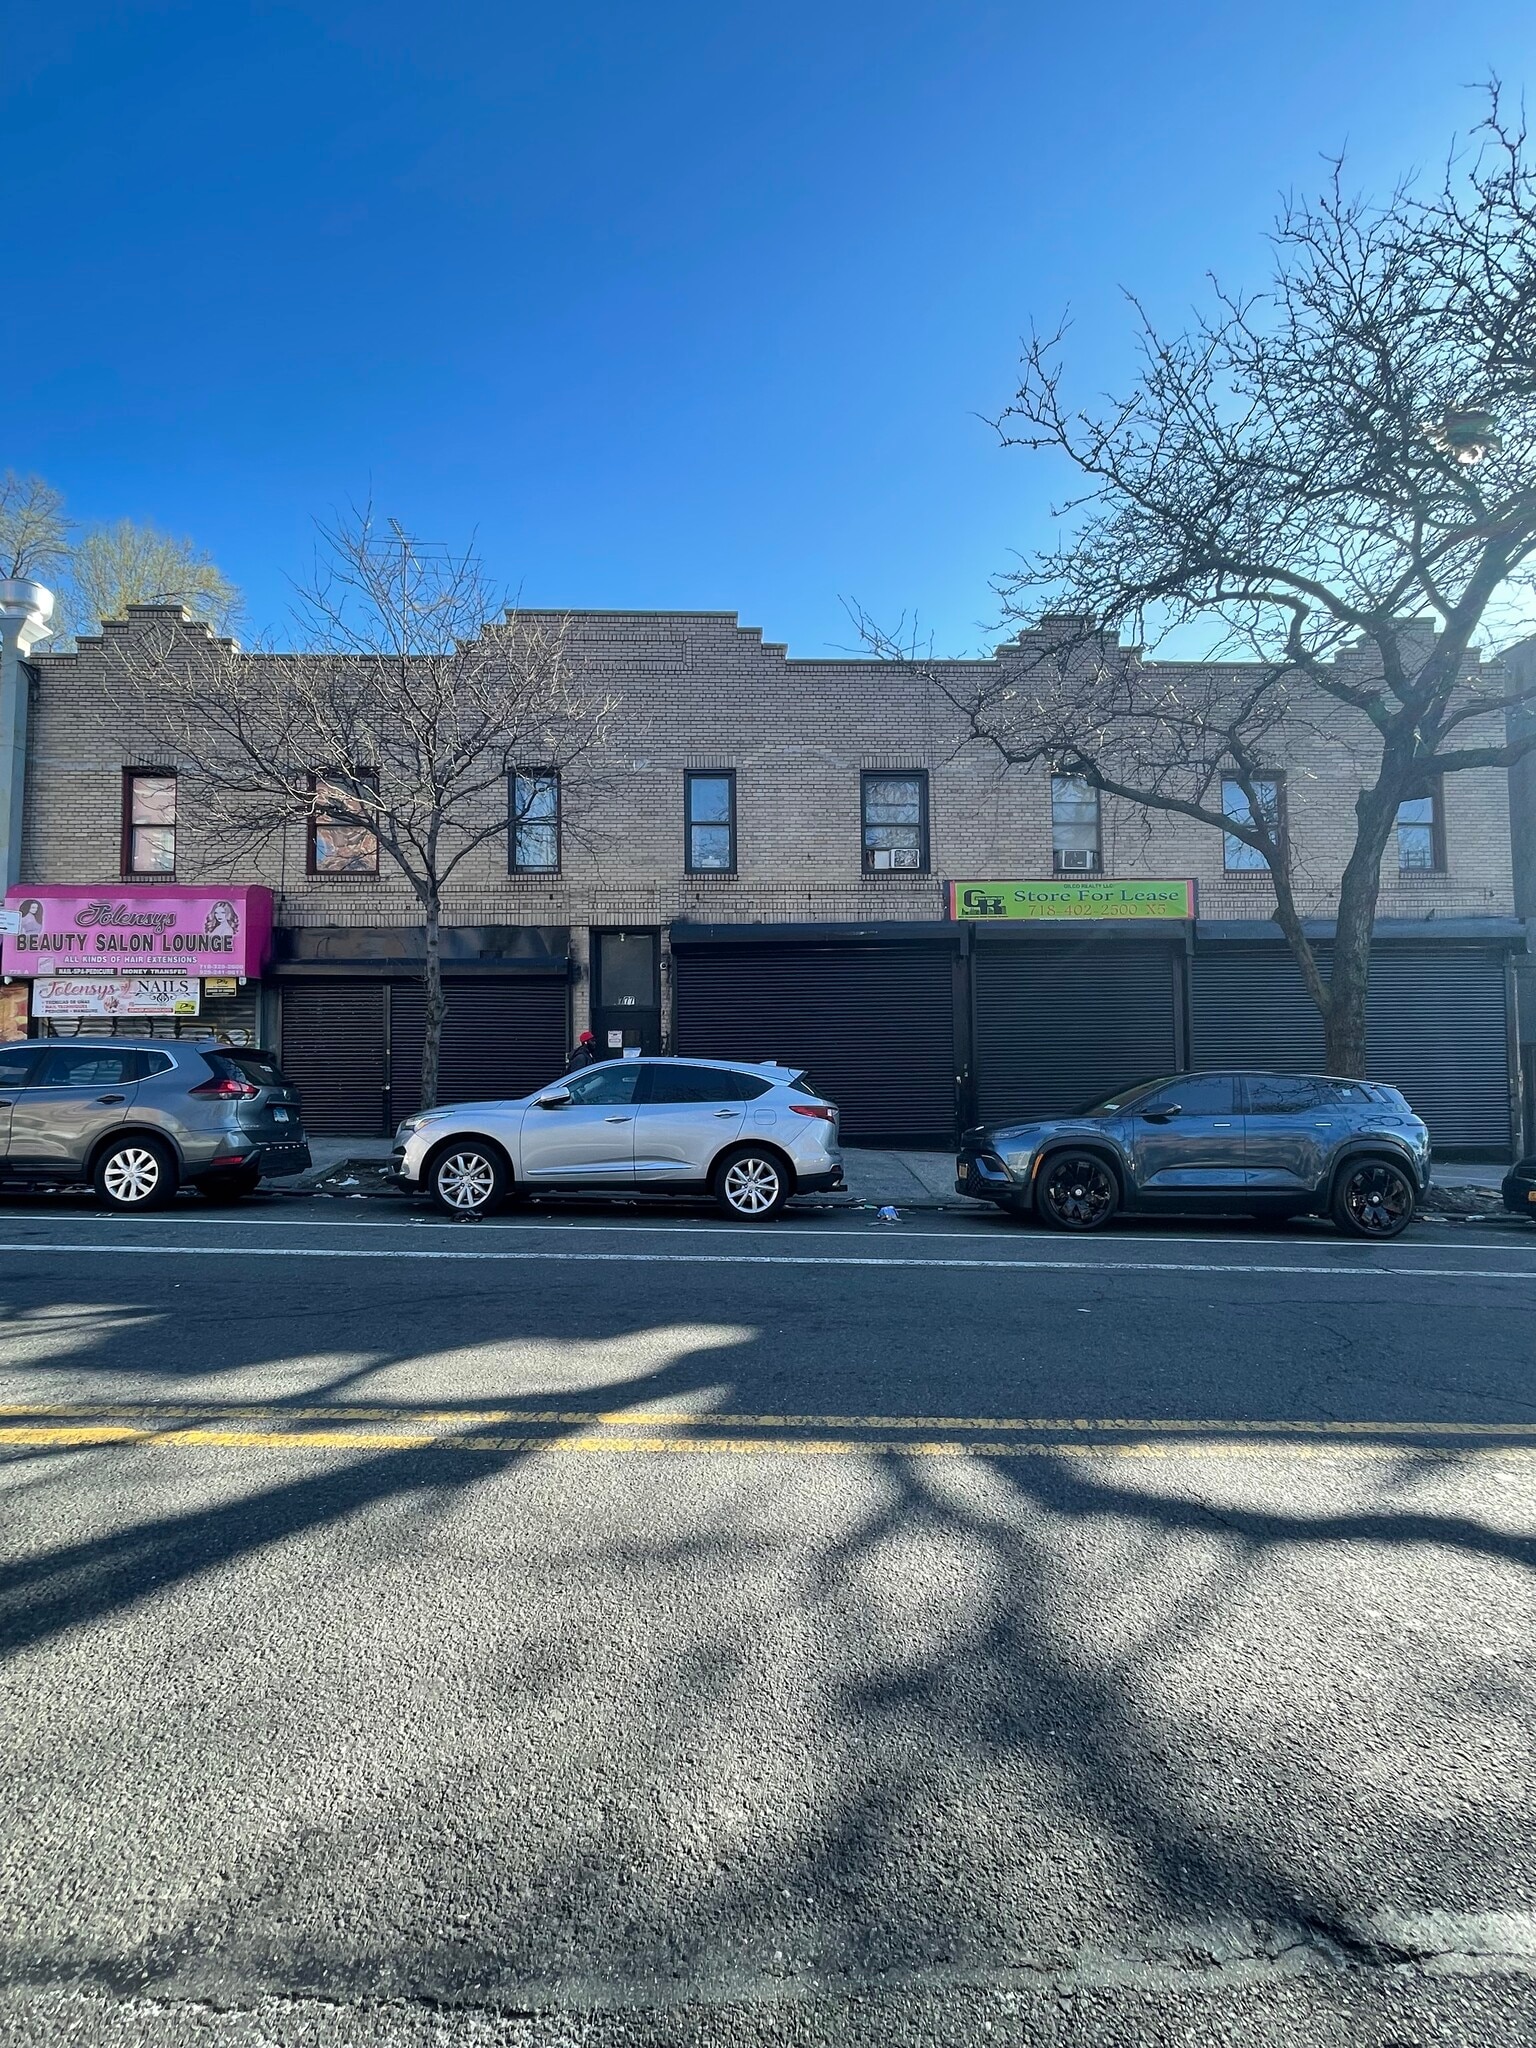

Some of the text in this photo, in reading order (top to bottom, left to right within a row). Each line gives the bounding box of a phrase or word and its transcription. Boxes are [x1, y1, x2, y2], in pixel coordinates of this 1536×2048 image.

[1014, 889, 1179, 902] Store For Lease
[1028, 904, 1166, 916] 718-402-2500 X5
[75, 902, 176, 934] Jolensys
[16, 933, 233, 953] BEAUTY SALON LOUNGE
[124, 956, 144, 964] HAIR
[146, 956, 198, 964] EXTENSIONS
[39, 981, 116, 1000] Jolensys
[137, 980, 189, 992] NAILS
